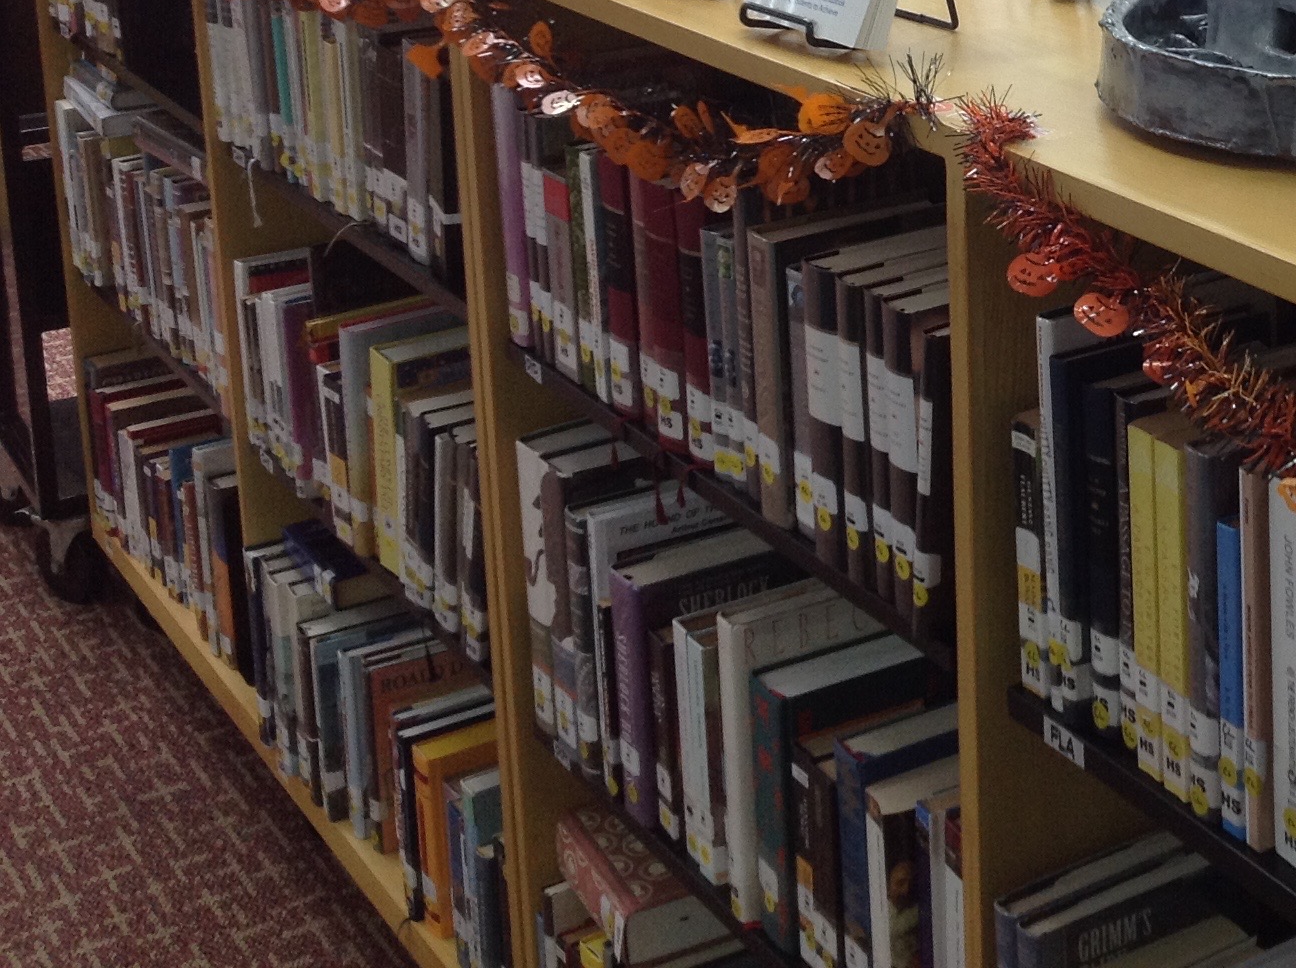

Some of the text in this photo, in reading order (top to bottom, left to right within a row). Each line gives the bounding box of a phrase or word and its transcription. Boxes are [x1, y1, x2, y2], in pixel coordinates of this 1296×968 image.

[619, 509, 704, 536] THE HOND OF
[1284, 534, 1296, 640] JOHN FOWLES
[743, 594, 864, 665] REBEC
[1139, 735, 1155, 757] HS
[1166, 757, 1181, 778] HS
[1221, 792, 1241, 815] HS
